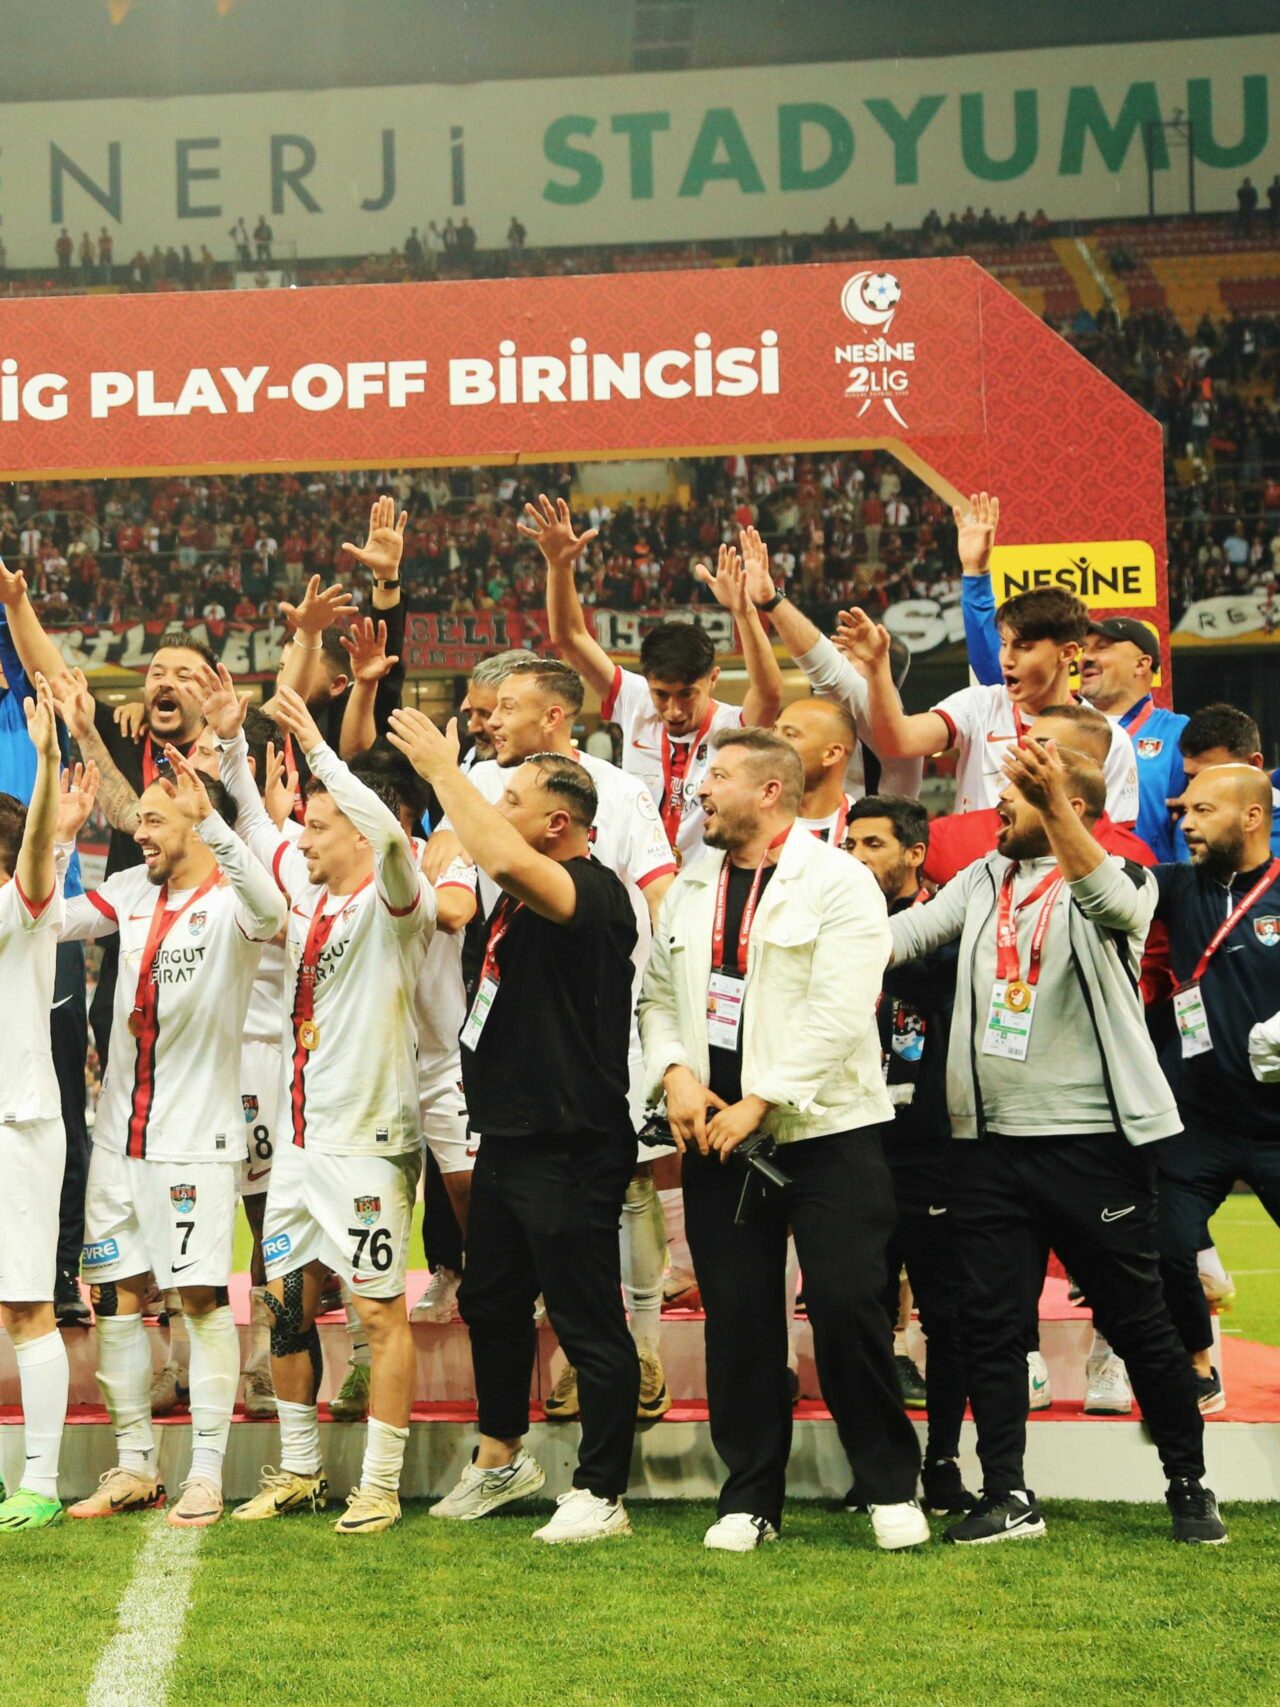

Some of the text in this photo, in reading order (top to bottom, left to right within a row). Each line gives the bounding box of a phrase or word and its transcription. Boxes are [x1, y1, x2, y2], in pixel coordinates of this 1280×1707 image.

[541, 74, 1268, 205] STADYUMU
[835, 337, 916, 364] NESİNE
[90, 359, 426, 419] PLAY-OFF
[449, 329, 780, 405] BİRİNCİSİ
[152, 946, 206, 965] URGUT
[175, 1220, 196, 1256] 7
[347, 1227, 394, 1272] 76
